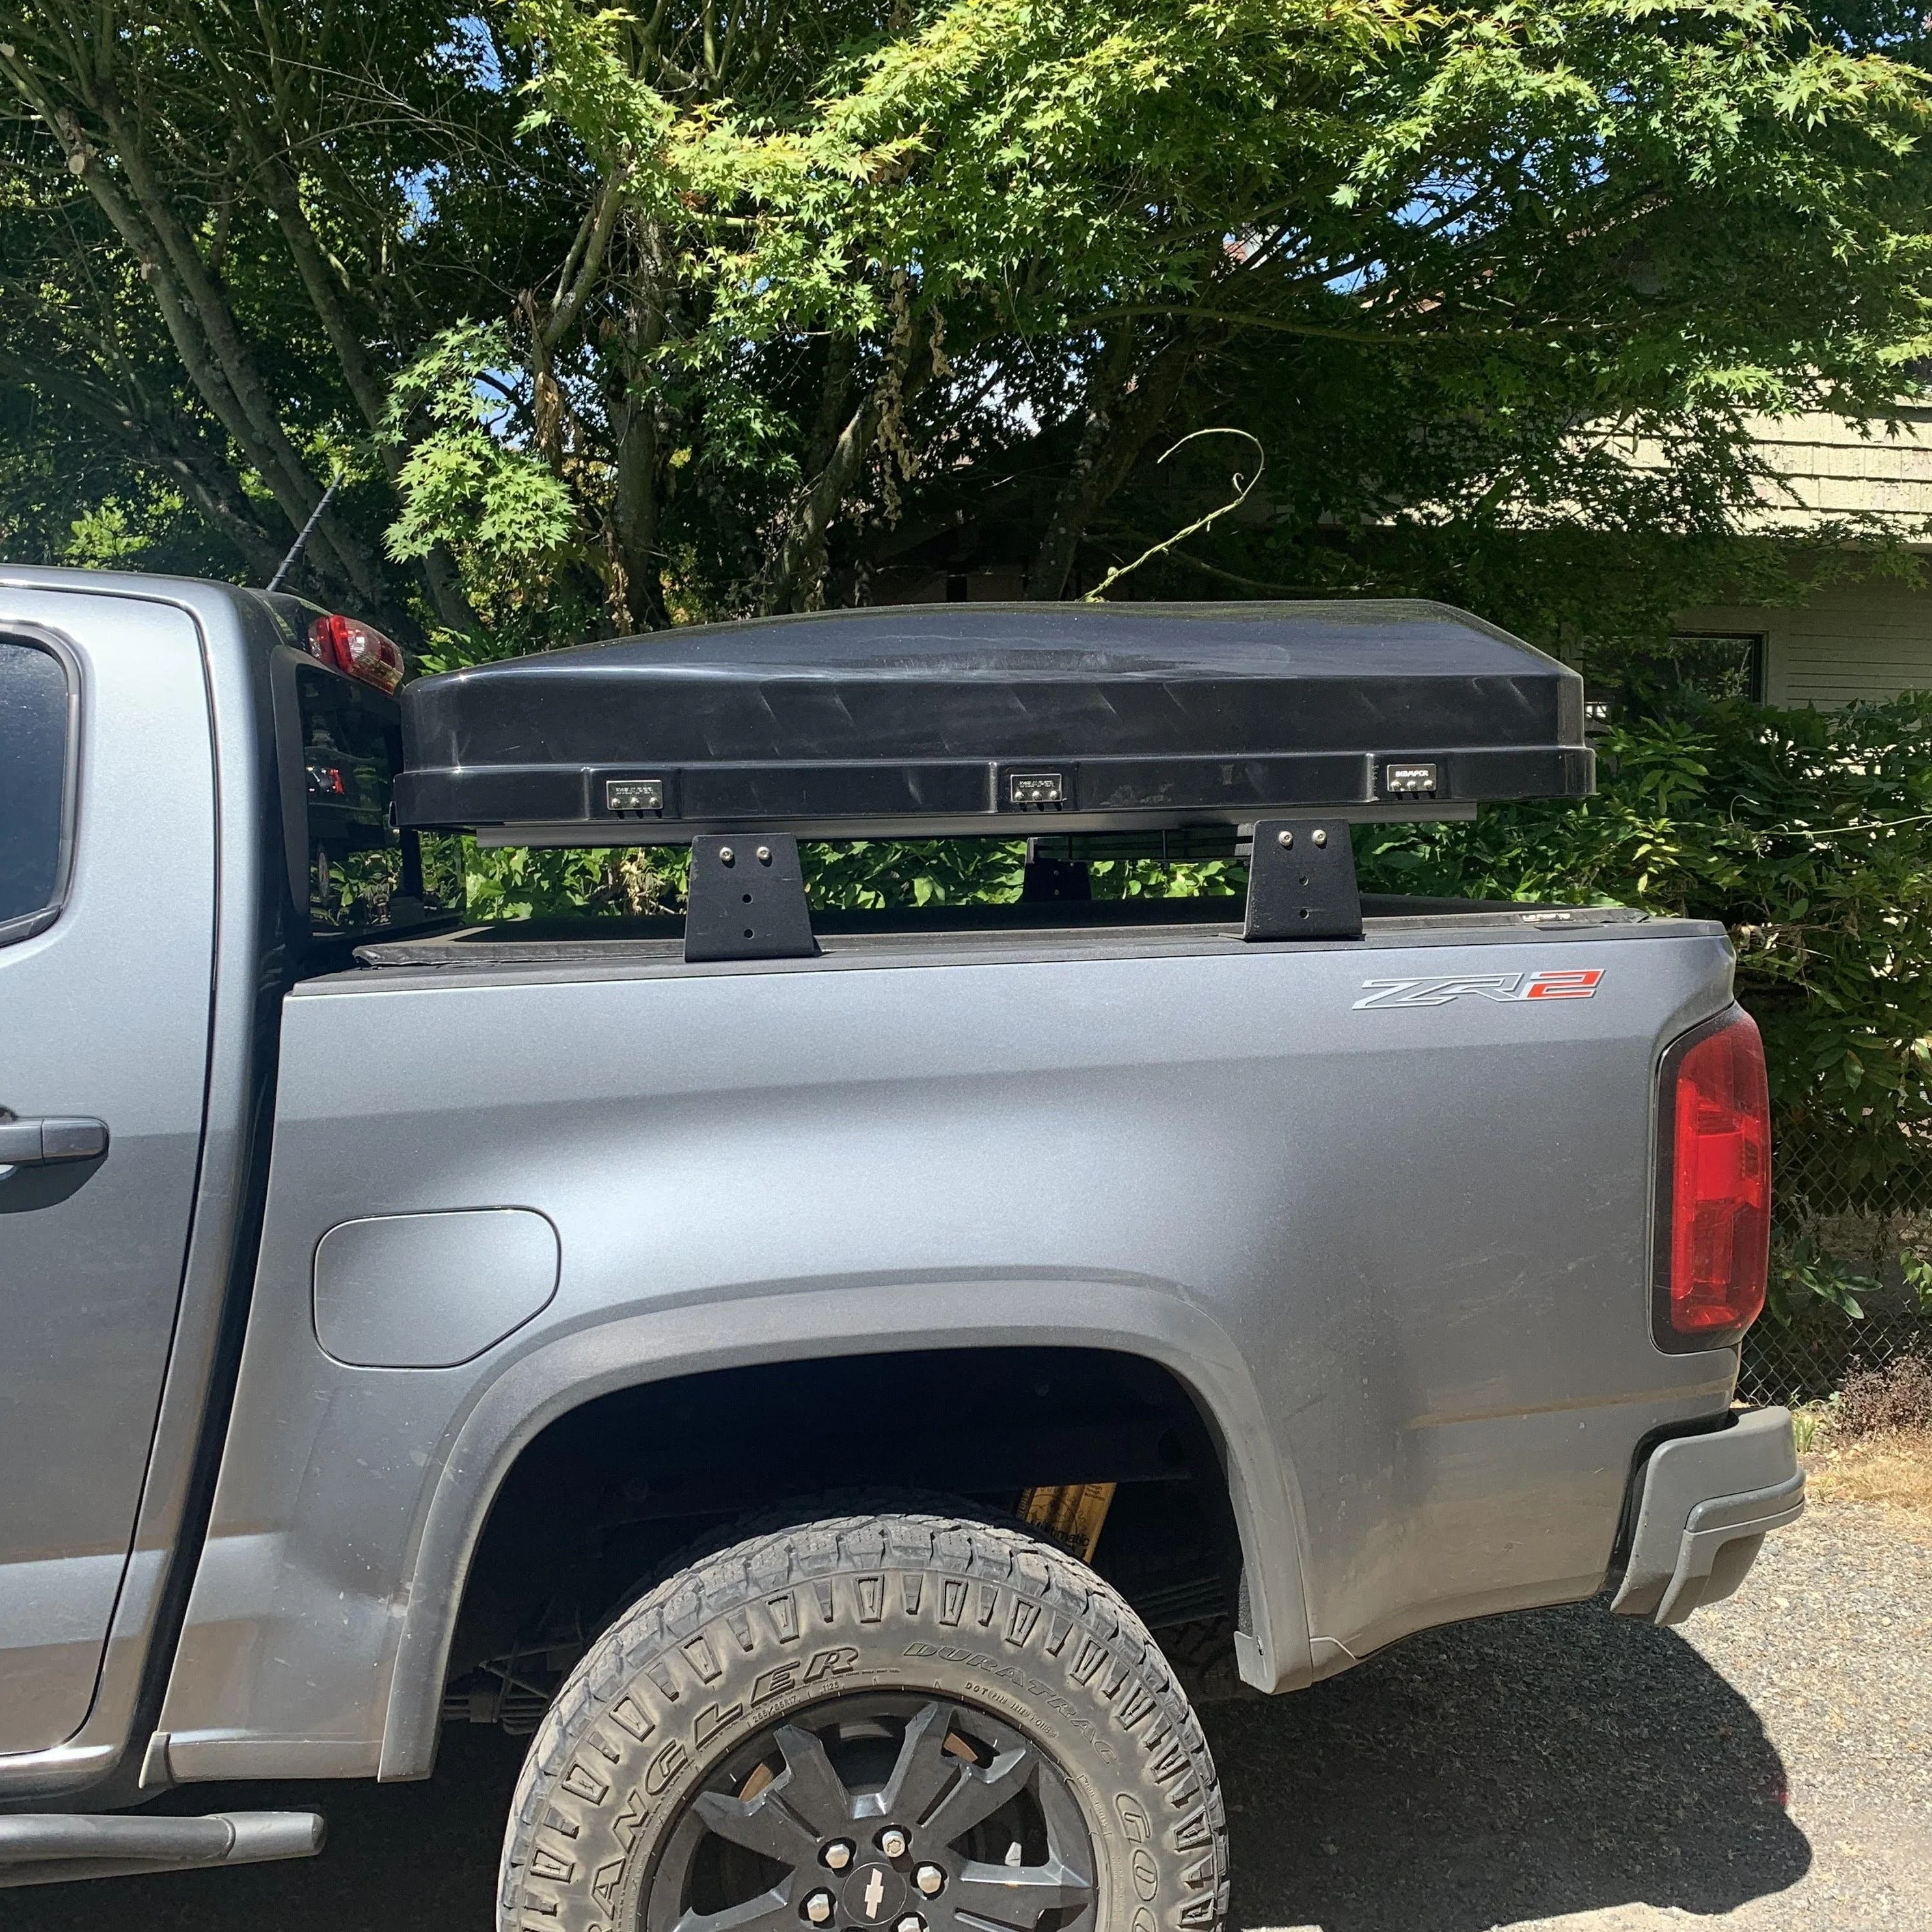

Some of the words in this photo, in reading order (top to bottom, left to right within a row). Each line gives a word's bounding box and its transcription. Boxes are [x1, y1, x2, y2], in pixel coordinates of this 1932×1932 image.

[1352, 968, 1605, 1010] ZR2
[903, 1642, 1117, 1765] DURATRAC
[964, 1681, 988, 1696] DOT
[588, 1646, 859, 1932] ANGLER
